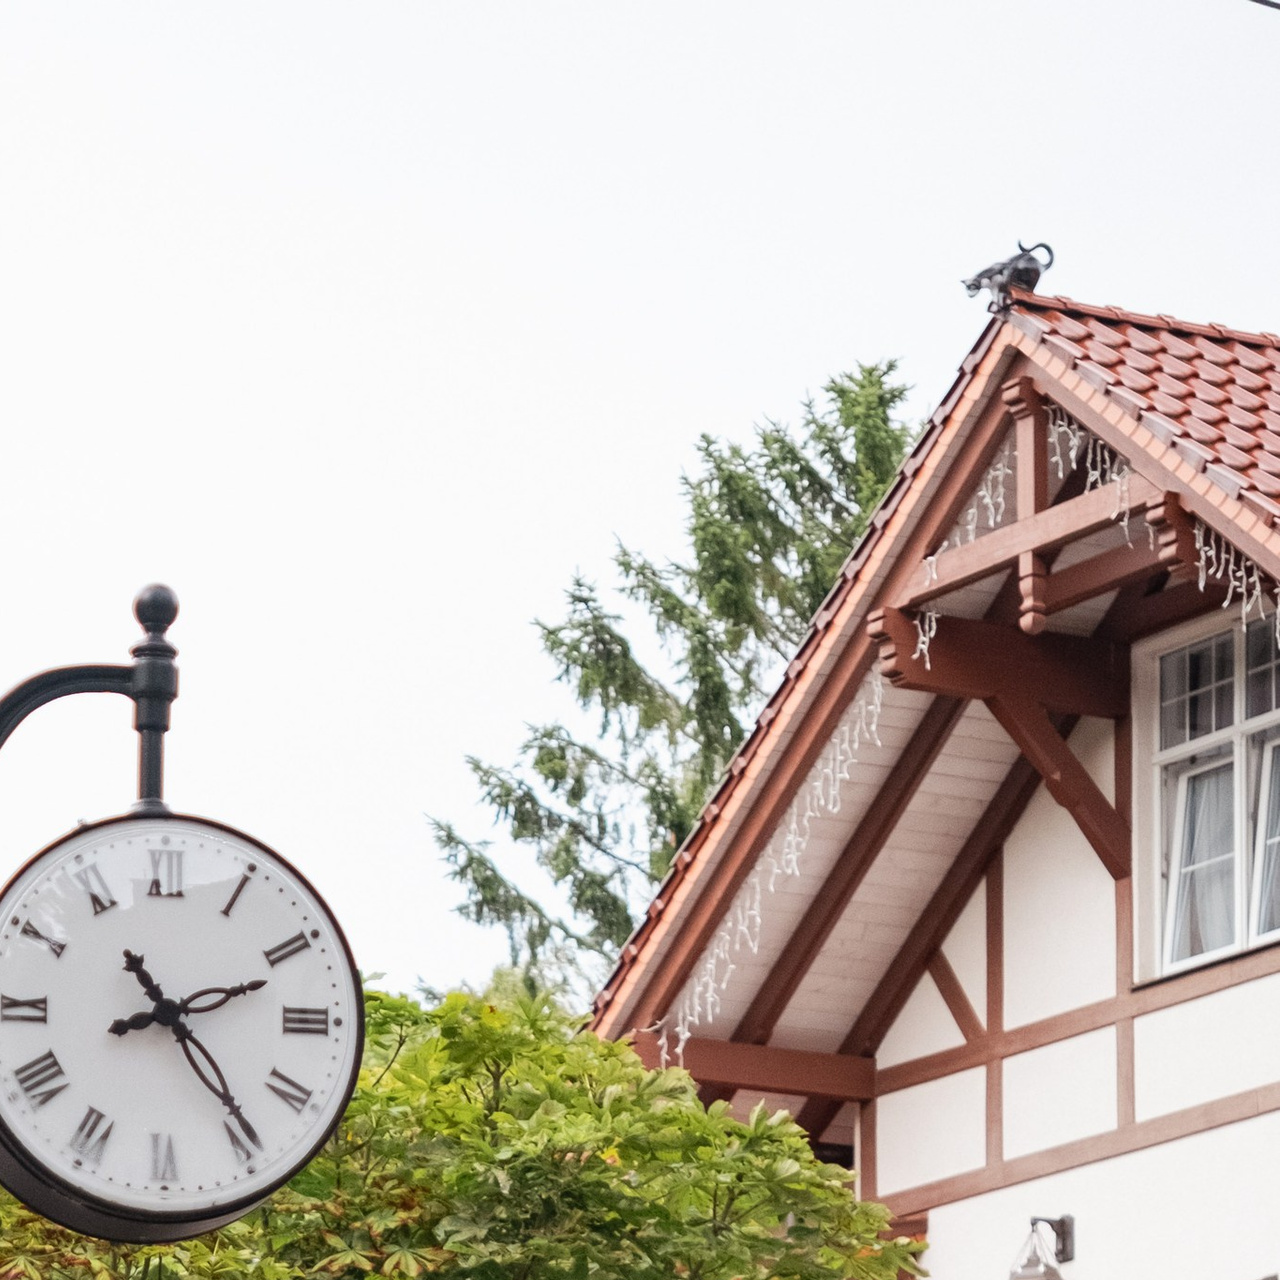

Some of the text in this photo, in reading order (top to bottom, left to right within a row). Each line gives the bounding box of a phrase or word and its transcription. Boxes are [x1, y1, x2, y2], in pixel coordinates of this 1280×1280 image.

[74, 863, 117, 916] XI
[148, 849, 184, 897] XII
[220, 873, 251, 916] I
[20, 918, 66, 958] X
[263, 930, 311, 967] II
[1, 993, 47, 1024] IX
[283, 1005, 328, 1036] III
[15, 1048, 70, 1113] VIII
[265, 1066, 313, 1114] IV
[69, 1105, 114, 1165] VII
[150, 1132, 180, 1181] VI
